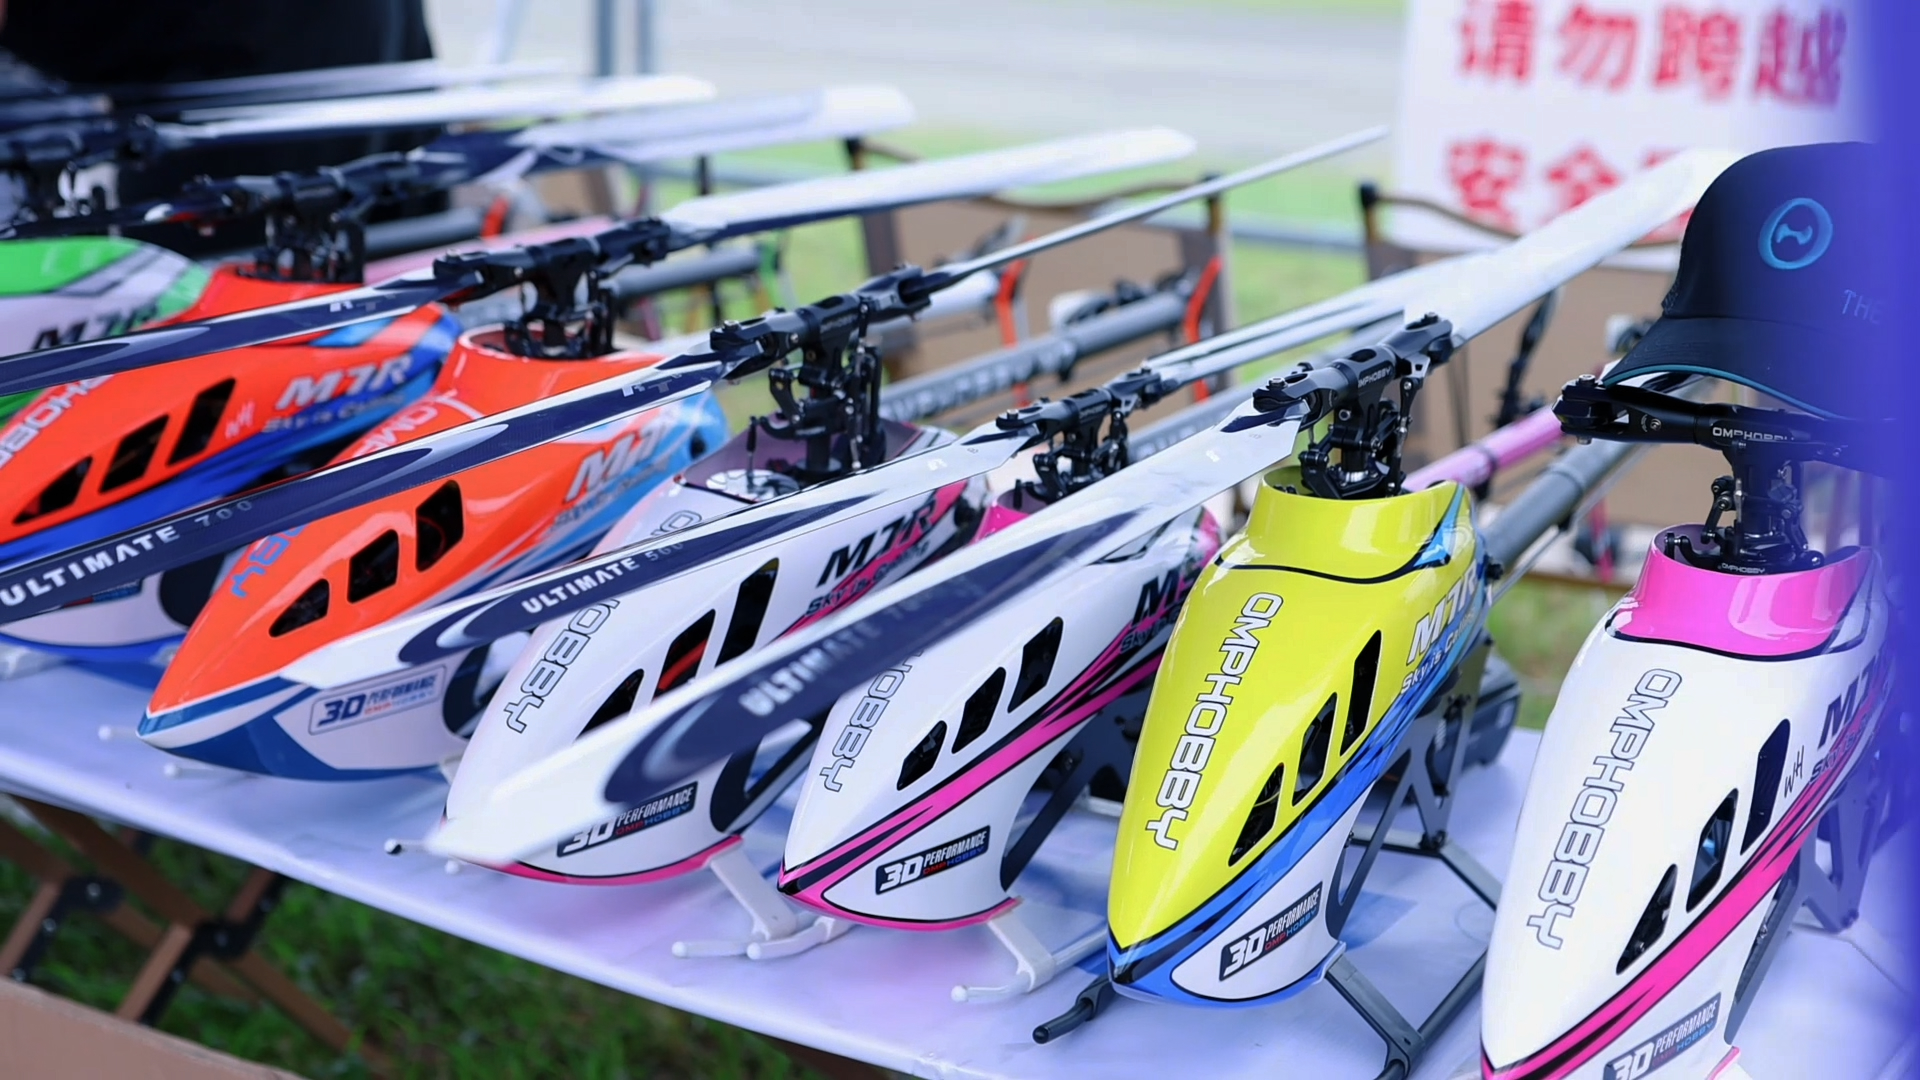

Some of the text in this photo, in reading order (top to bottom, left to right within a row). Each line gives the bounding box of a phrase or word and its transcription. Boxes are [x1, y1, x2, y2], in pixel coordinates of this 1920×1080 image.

[1459, 0, 1846, 108] 请勿跨越
[275, 352, 413, 411] M7R
[0, 525, 180, 607] ULTIMATE
[194, 500, 252, 527] 700
[521, 557, 641, 615] ULTIMATE
[815, 494, 937, 588] M7R
[1405, 559, 1480, 668] M7R
[317, 693, 367, 728] 3D
[1145, 591, 1284, 851] OMPHOBBY
[617, 786, 694, 828] PERFORMANCE
[1526, 667, 1683, 950] OMPHOBBY
[879, 830, 988, 892] 3D PERFORMANCE
[1223, 887, 1321, 978] 3D PERFORMANCE
[1653, 999, 1718, 1058] PERFORMANCE
